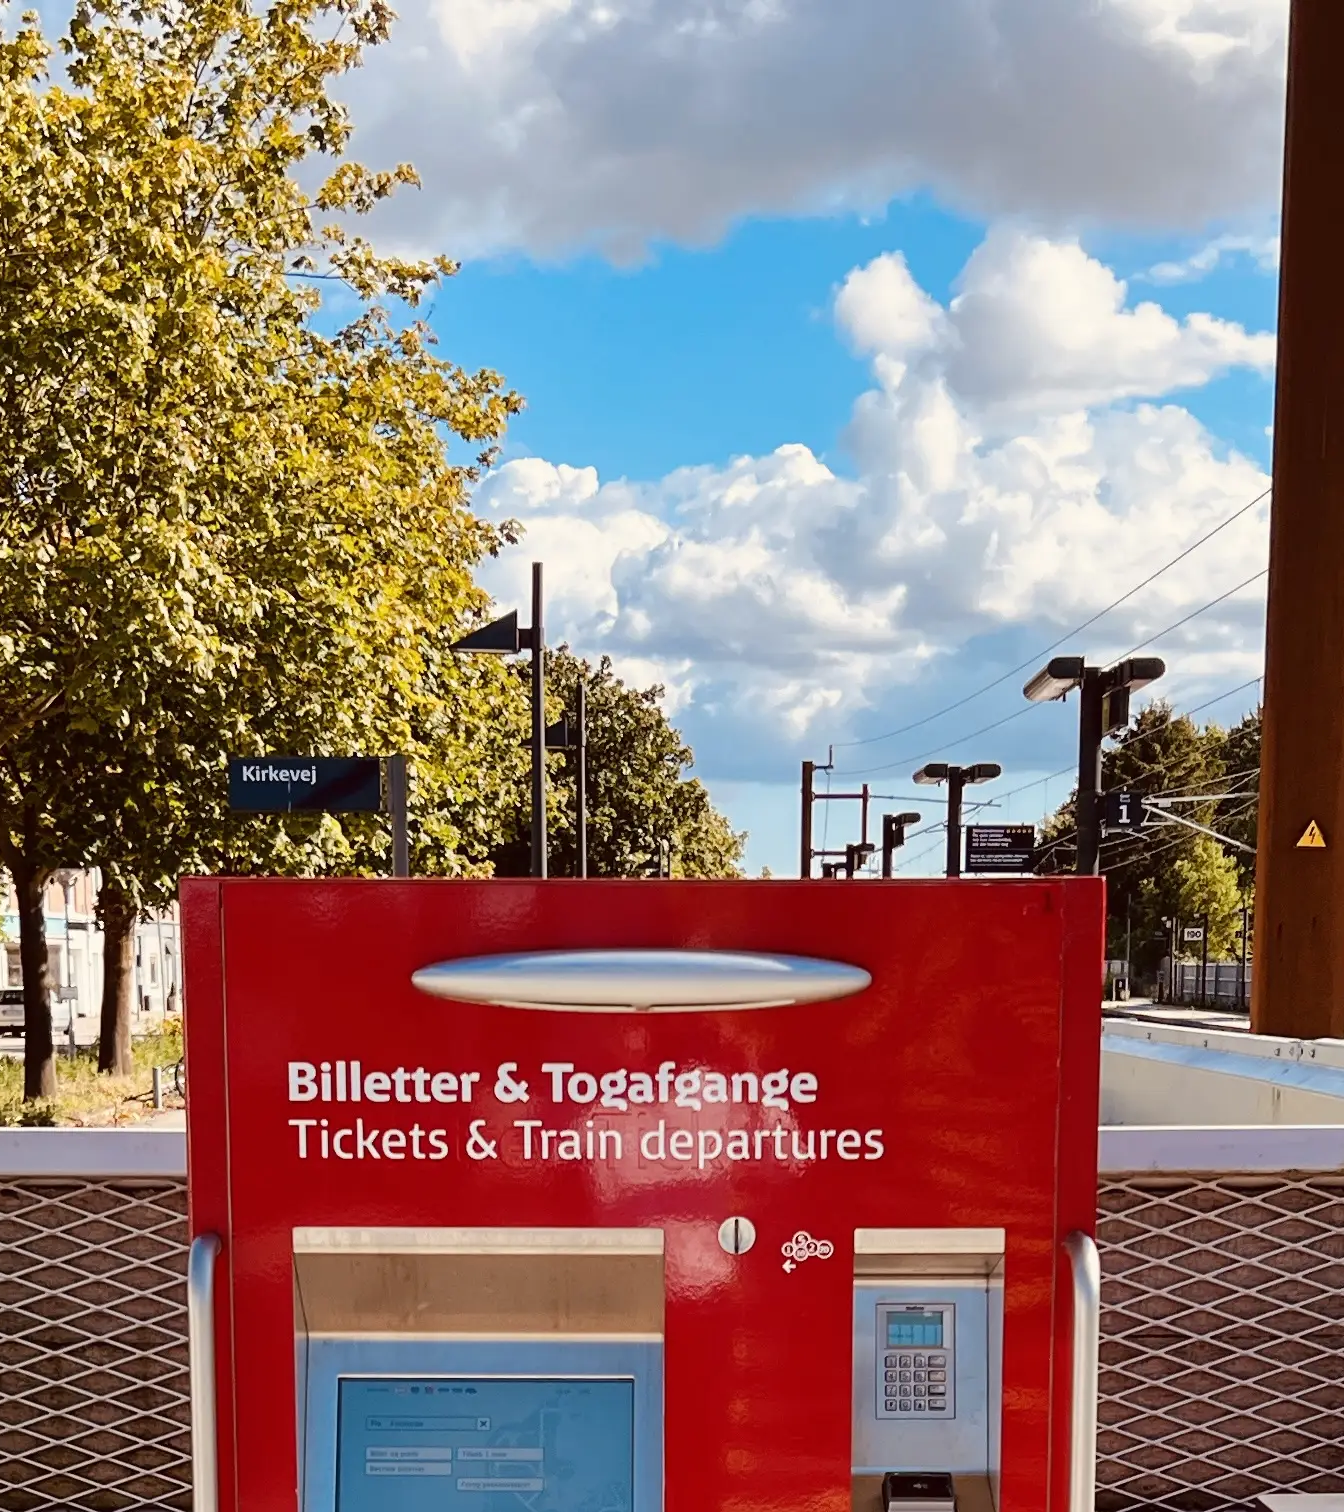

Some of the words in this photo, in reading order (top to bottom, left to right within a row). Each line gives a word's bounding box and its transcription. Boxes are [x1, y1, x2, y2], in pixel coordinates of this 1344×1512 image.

[242, 765, 317, 785] Kirkevej
[1118, 804, 1131, 824] 1
[1186, 930, 1201, 938] 190
[288, 1061, 480, 1103] Billetter
[494, 1062, 537, 1103] &
[542, 1062, 818, 1112] Togafgange
[288, 1119, 449, 1160] Tickets
[466, 1120, 498, 1160] &
[513, 1120, 622, 1160] Train
[640, 1119, 884, 1165] departures
